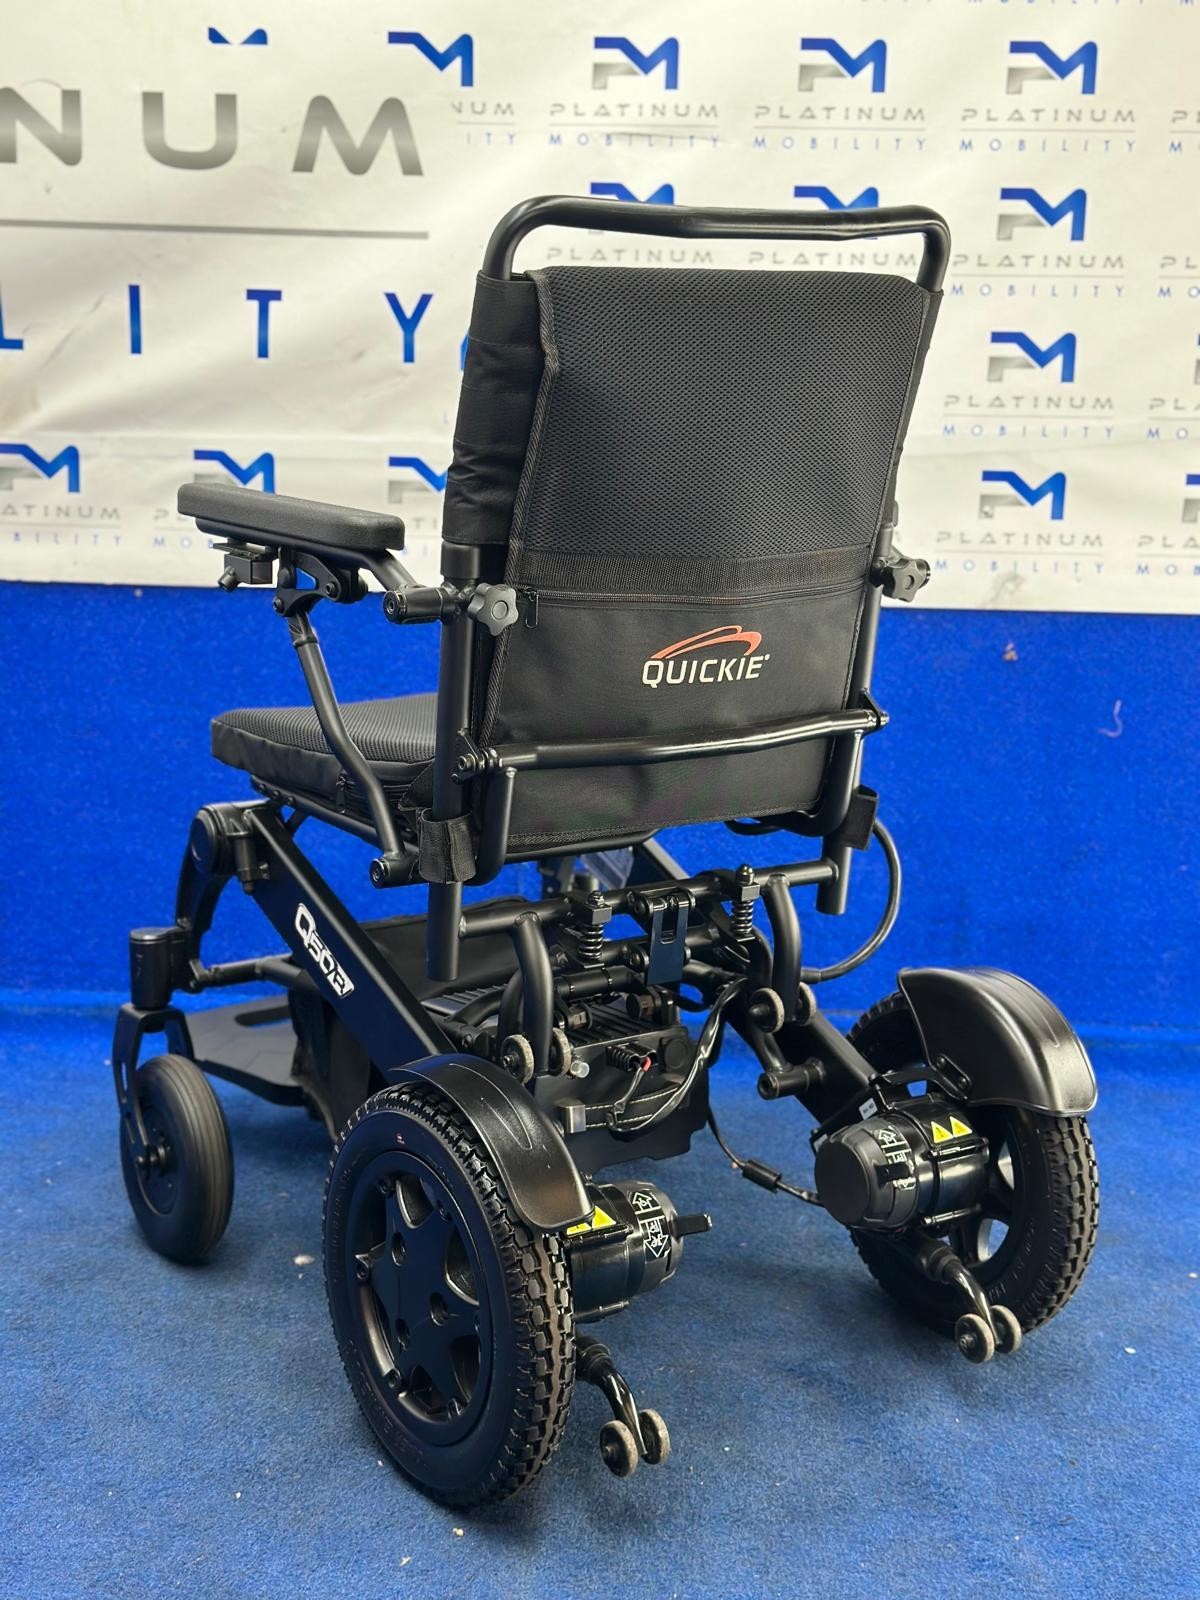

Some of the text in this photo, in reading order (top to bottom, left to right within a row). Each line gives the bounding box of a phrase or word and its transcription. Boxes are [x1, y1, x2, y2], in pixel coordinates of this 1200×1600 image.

[549, 103, 719, 118] PLATINUM
[754, 105, 926, 121] PLATINUM
[961, 108, 1136, 123] PLATINUM
[0, 86, 424, 176] NUM
[548, 133, 720, 148] MOBILITY
[753, 136, 926, 151] MOBILITY
[959, 138, 1136, 153] MOBILITY
[546, 247, 714, 263] PLATINUM
[748, 251, 917, 267] PLATINUM
[952, 253, 1125, 270] PLATINUM
[950, 283, 1126, 298] MOBILITY
[0, 280, 434, 364] LITY
[943, 394, 1114, 410] PLATINUM
[942, 424, 1114, 438] MOBILITY
[935, 531, 1103, 547] PLATINUM
[934, 559, 1104, 574] MOBILITY
[642, 655, 767, 688] QUICKIE
